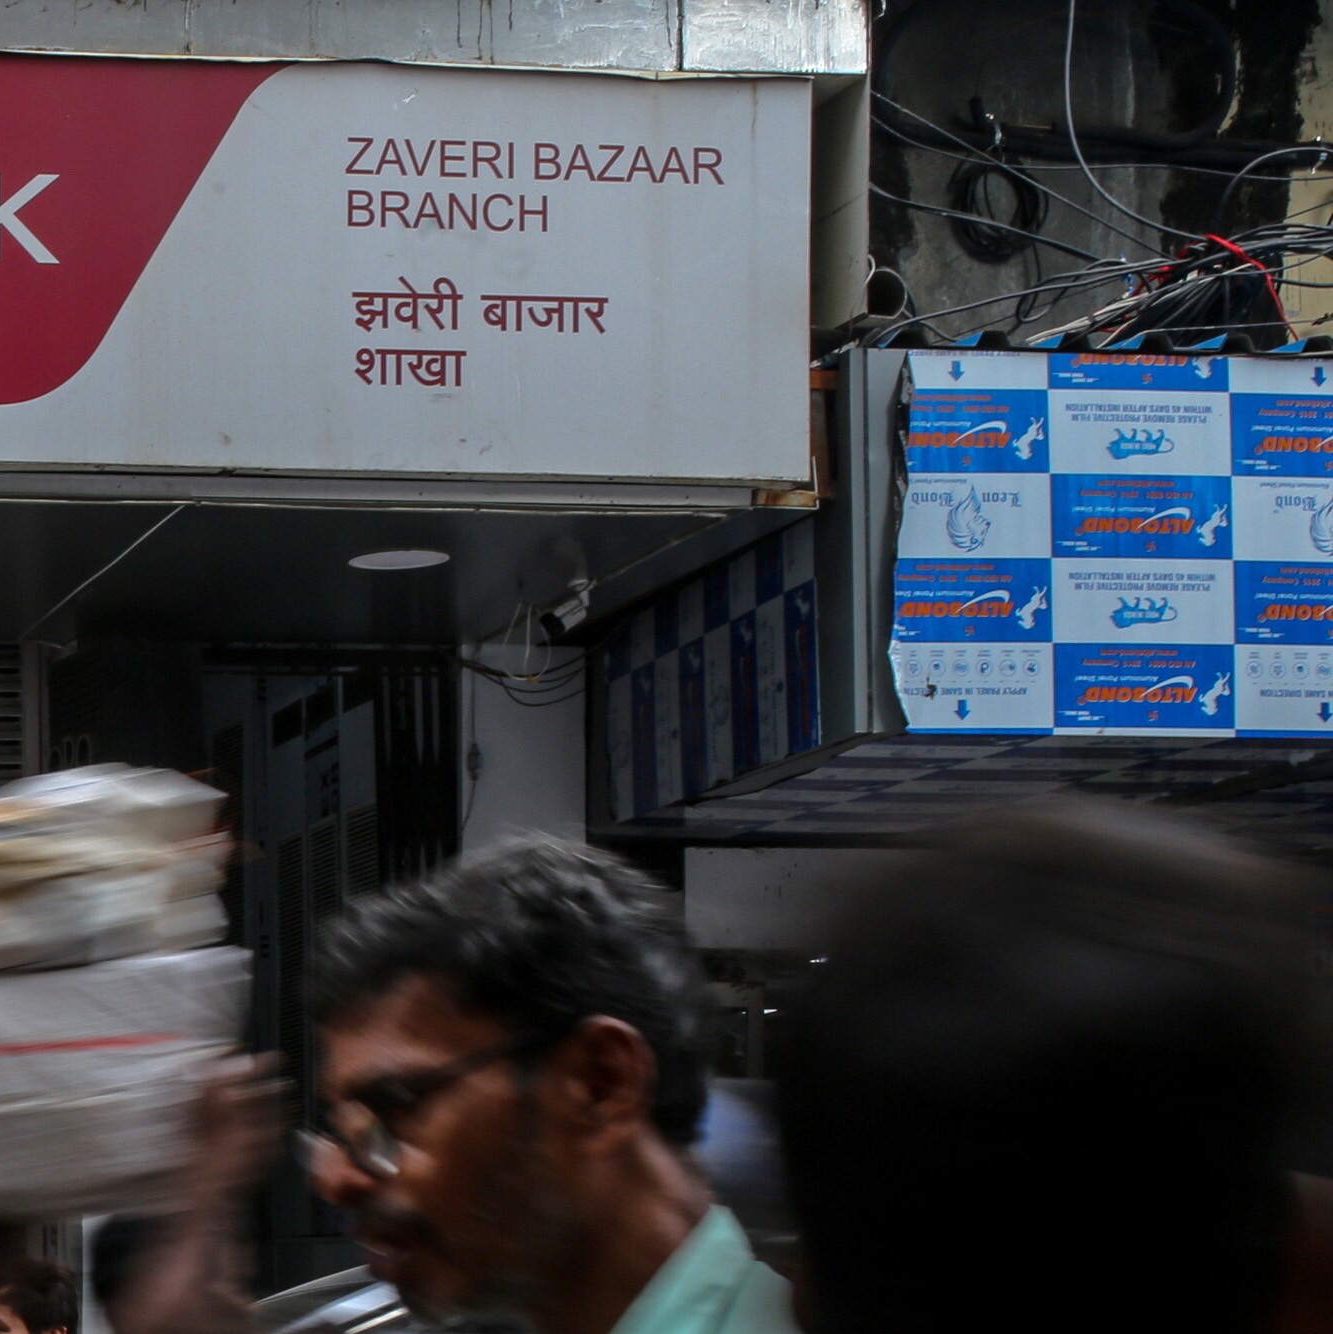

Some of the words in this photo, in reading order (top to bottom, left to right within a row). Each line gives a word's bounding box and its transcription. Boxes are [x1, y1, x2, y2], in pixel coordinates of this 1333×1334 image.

[344, 136, 515, 180] ZAVERI
[533, 142, 725, 186] BAZAAR
[346, 189, 549, 233] BRANCH
[351, 276, 464, 332] झवेरी
[480, 293, 609, 335] बाजार
[353, 347, 467, 388] शाखा
[1065, 403, 1121, 412] INSTALLATION
[1122, 404, 1147, 413] AFTER
[1149, 404, 1170, 413] DAYS
[1183, 405, 1212, 414] WITHIN
[1071, 413, 1091, 422] FILM
[1093, 414, 1141, 422] PROTECTIVE
[1142, 414, 1175, 423] REMOVE
[1177, 414, 1207, 423] PLEASE
[911, 492, 953, 508] Bond
[982, 492, 1022, 508] Leon
[1275, 495, 1317, 512] Bond
[1082, 517, 1195, 534] ALTOBOND
[1069, 572, 1124, 581] INSTALLATION
[1125, 572, 1152, 581] AFTER
[1153, 572, 1174, 581] DAYS
[1187, 573, 1216, 582] WITHIN
[1074, 582, 1094, 591] FILM
[1096, 582, 1144, 591] PROTECTIVE
[1145, 583, 1179, 592] REMOVE
[1180, 583, 1211, 592] PLEASE
[900, 601, 1014, 617] ALTOBOND
[940, 687, 963, 695] SAME
[976, 687, 1000, 695] PANEL
[1002, 687, 1027, 696] APPLY
[1085, 686, 1198, 703] ALTOBOND
[1260, 689, 1302, 698] DIRECTION
